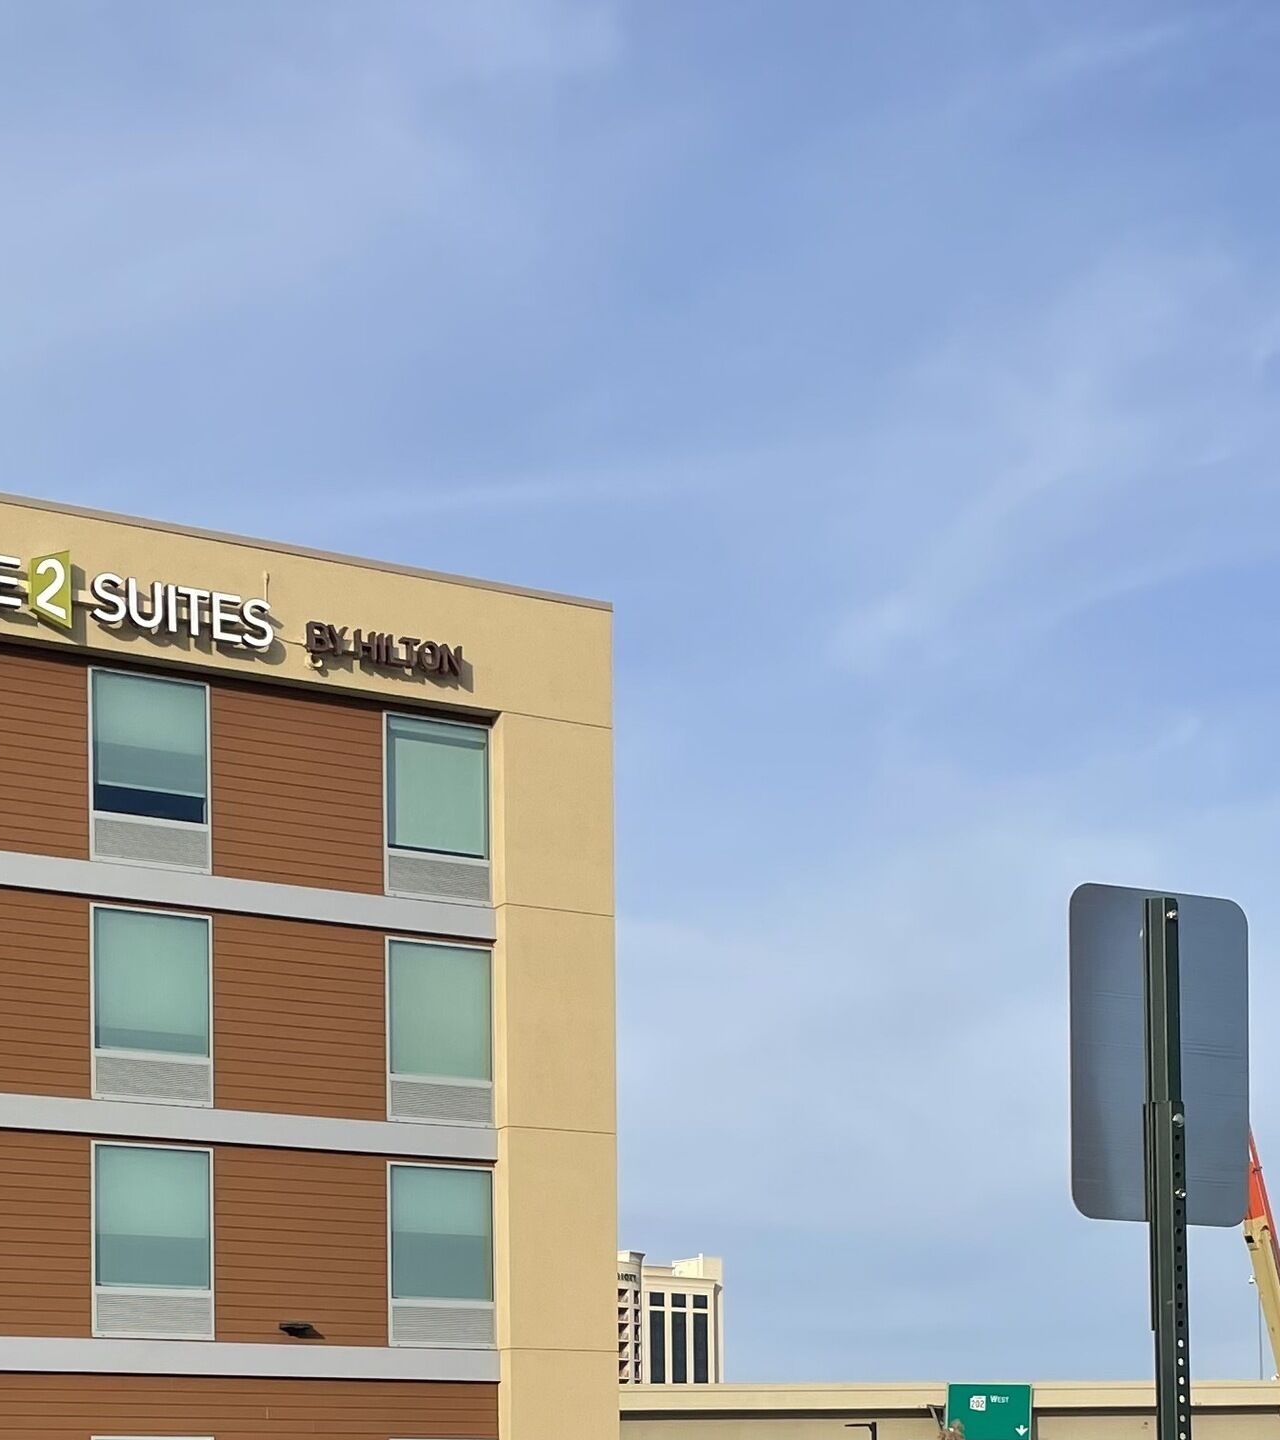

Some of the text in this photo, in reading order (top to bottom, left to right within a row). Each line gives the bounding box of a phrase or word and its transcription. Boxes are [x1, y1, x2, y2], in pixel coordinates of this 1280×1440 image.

[35, 558, 67, 620] 2
[90, 572, 274, 648] SUITES
[306, 620, 348, 656] BY
[352, 628, 463, 677] HILTON
[970, 1400, 985, 1408] 202
